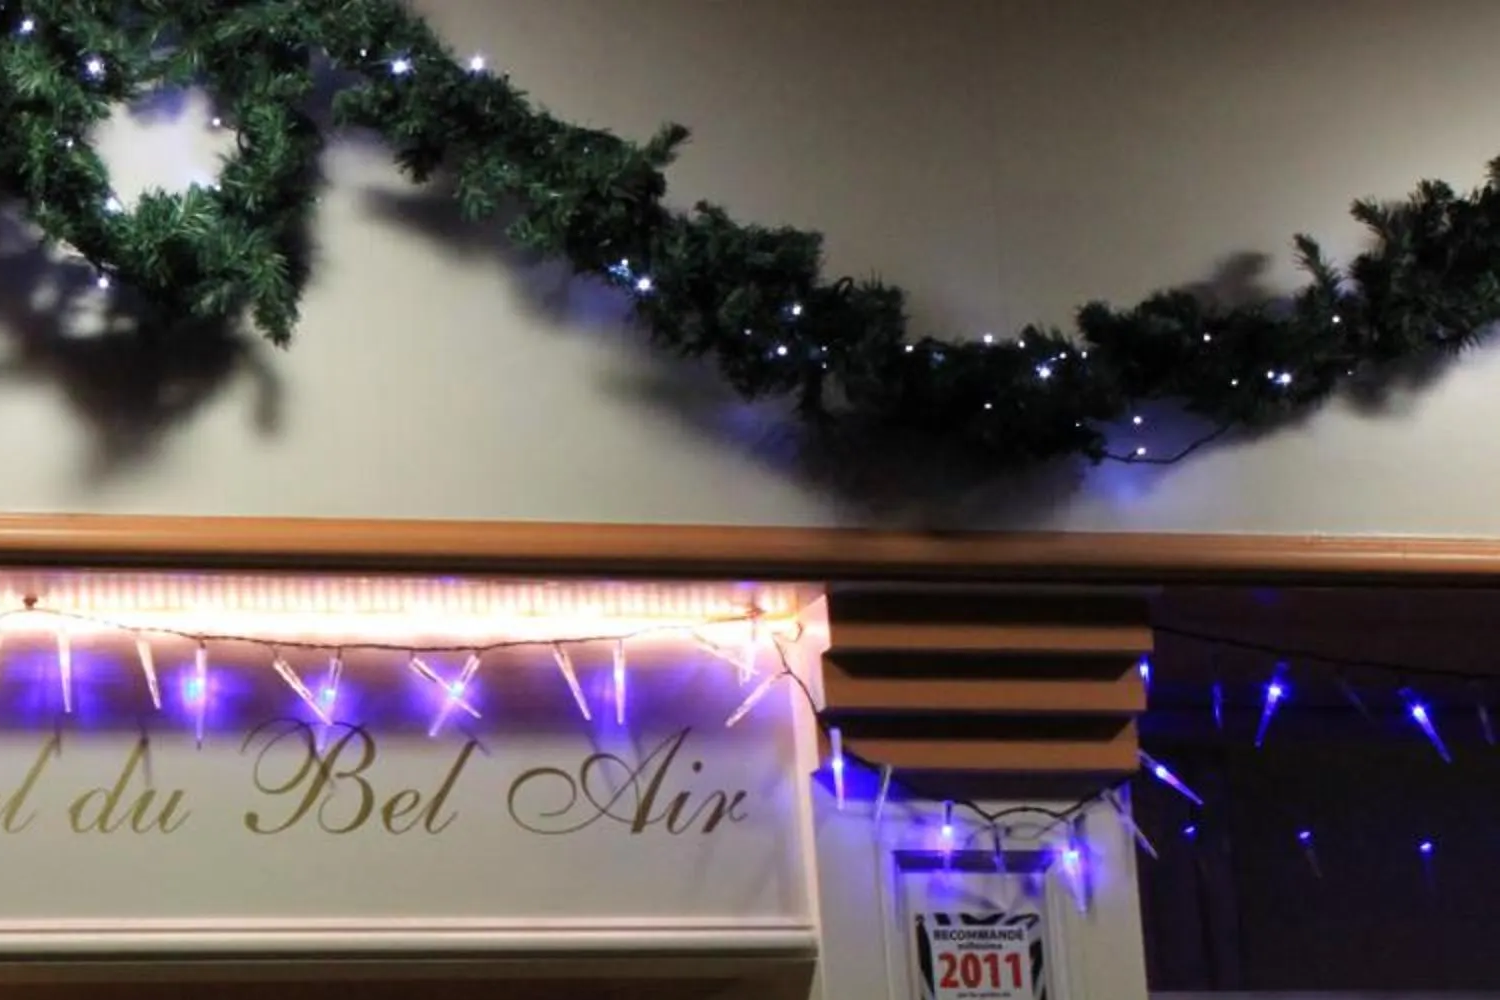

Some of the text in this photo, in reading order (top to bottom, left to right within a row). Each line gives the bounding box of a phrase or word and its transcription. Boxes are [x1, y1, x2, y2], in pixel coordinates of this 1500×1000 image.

[69, 738, 190, 835] du
[241, 718, 476, 835] Bel
[507, 726, 748, 835] Air
[938, 952, 1023, 988] 2011
